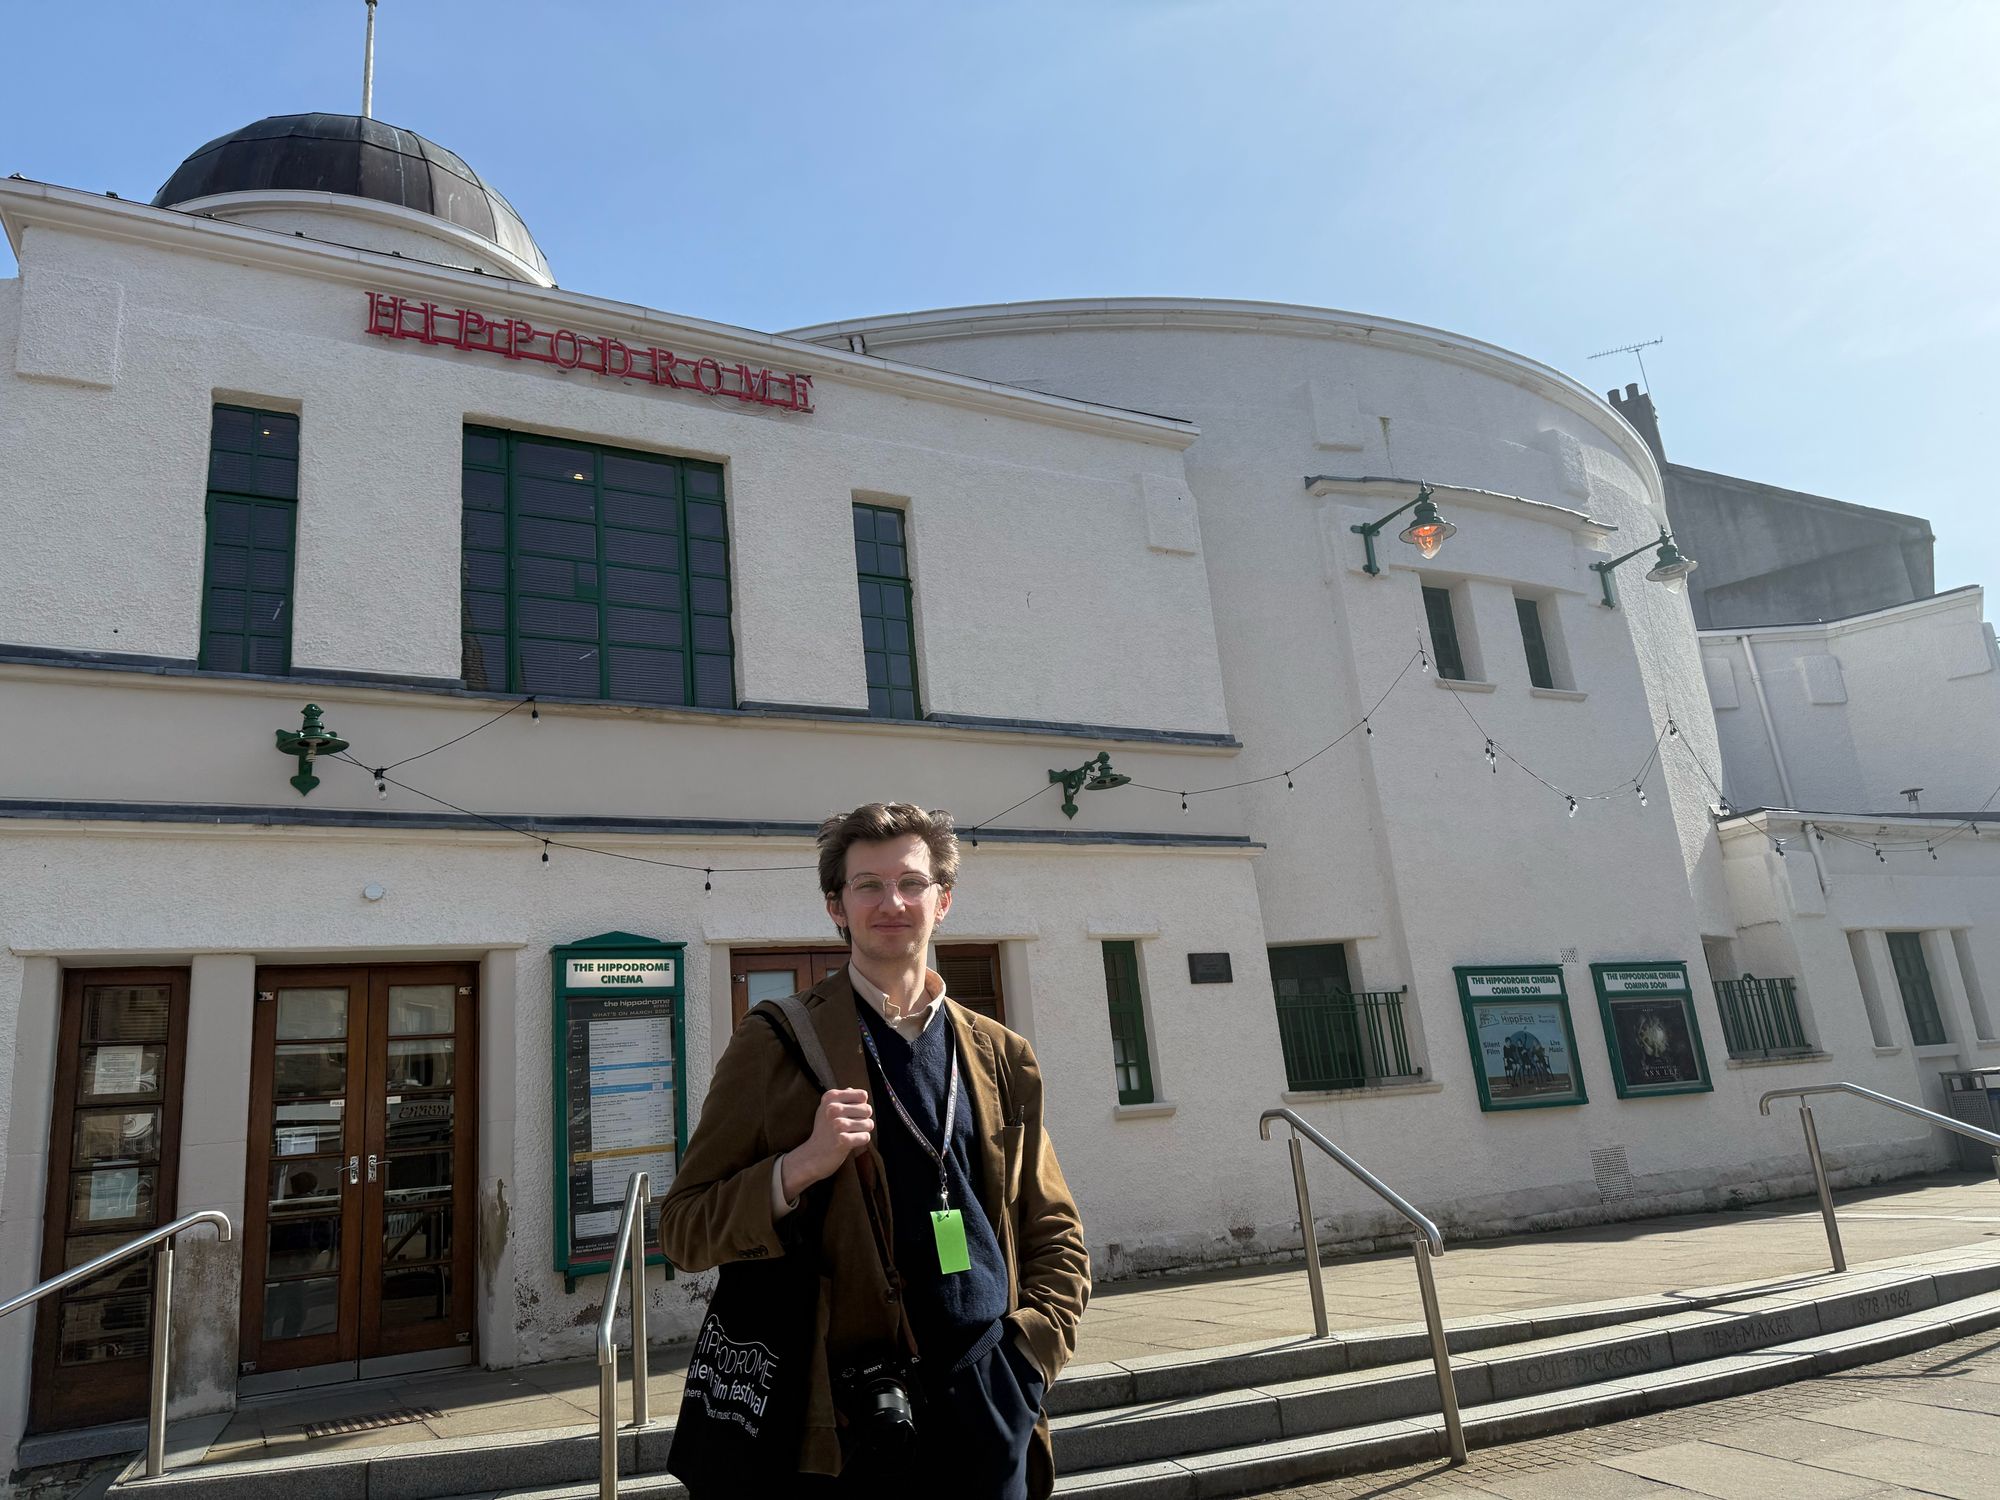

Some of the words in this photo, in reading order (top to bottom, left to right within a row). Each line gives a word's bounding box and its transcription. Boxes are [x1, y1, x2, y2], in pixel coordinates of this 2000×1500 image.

[365, 291, 815, 413] HIPPODROME
[573, 963, 594, 972] THE
[597, 962, 670, 972] HIPPODROME
[601, 975, 643, 984] CINEMA
[1486, 976, 1530, 984] HIPPODROME
[1531, 976, 1556, 984] CINEMA
[1619, 972, 1658, 980] HIPPODROME
[1492, 986, 1520, 994] COMING
[1521, 986, 1541, 994] SOON
[620, 998, 670, 1006] hippodrome
[1571, 1344, 1651, 1374] DICKSON
[864, 1364, 882, 1374] SONY
[729, 1379, 768, 1416] festival
